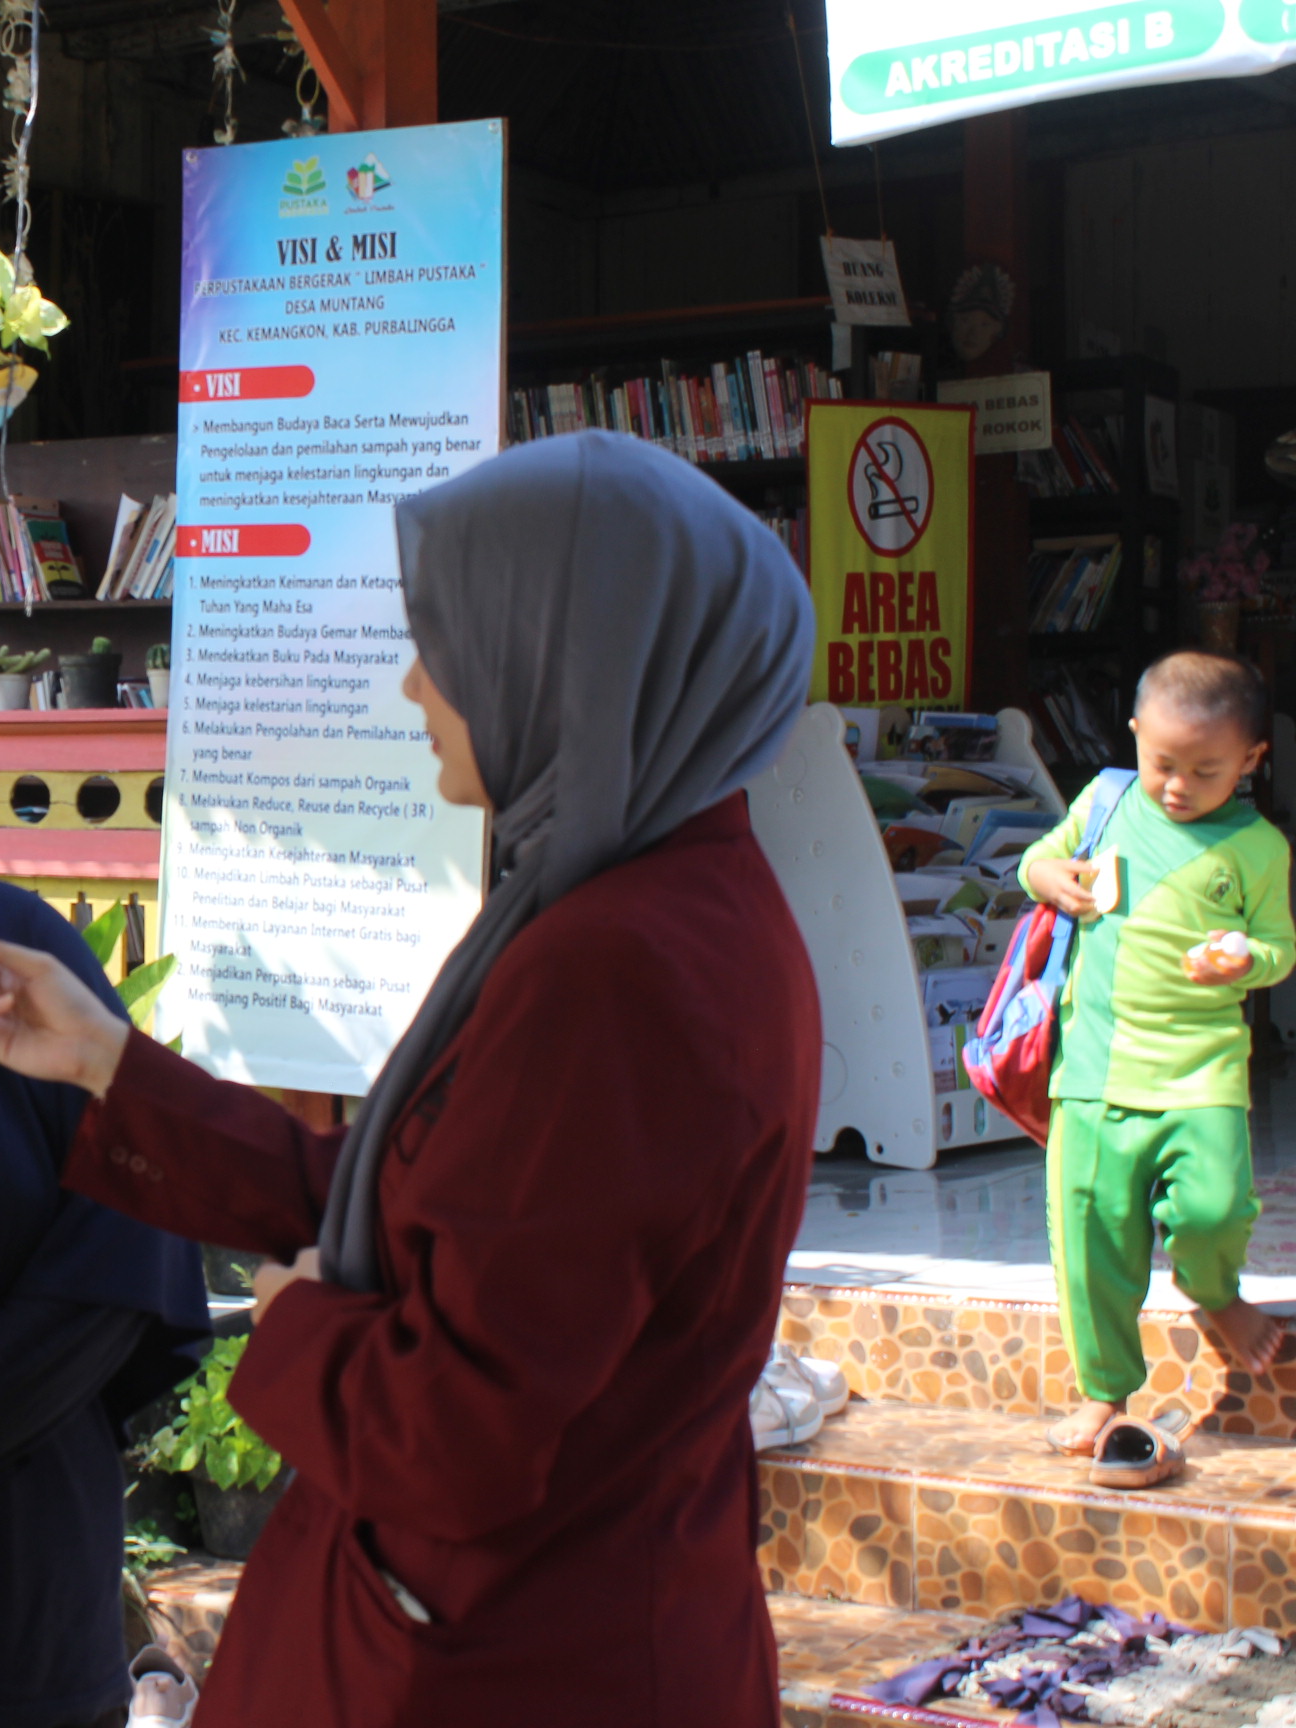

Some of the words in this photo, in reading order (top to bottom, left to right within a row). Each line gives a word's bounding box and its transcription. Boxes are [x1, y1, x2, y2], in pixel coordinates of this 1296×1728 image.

[884, 17, 1130, 98] AKREDITASI
[1145, 11, 1175, 49] B
[277, 238, 318, 266] VISI
[325, 235, 343, 263] &
[351, 232, 397, 260] MISI
[194, 276, 285, 296] PERPUSTAKAAN
[289, 273, 351, 290] BERGERAK
[365, 268, 414, 285] LIMBAH
[418, 265, 476, 282] PUSTAKA
[285, 300, 316, 315] DESA
[319, 296, 385, 313] MUNTANG
[219, 327, 243, 343] KEC.
[247, 323, 329, 342] KEMANGKON,
[333, 321, 361, 337] KAB.
[364, 318, 456, 336] PURBALINGGA
[206, 373, 241, 397] VISI
[985, 395, 1039, 410] BEBAS
[204, 419, 274, 436] Membangun
[278, 417, 319, 434] Budaya
[323, 416, 351, 429] Baca
[354, 415, 385, 428] Serta
[389, 412, 468, 430] Mewujudkan
[983, 420, 1042, 436] ROKOK
[201, 444, 268, 460] Pengelolaan
[272, 444, 293, 456] dan
[296, 441, 358, 459] pemilahan
[362, 440, 408, 457] sampah
[411, 441, 441, 455] yang
[446, 438, 481, 452] benar
[200, 468, 232, 483] untuk
[235, 469, 283, 485] menjaga
[288, 465, 350, 480] kelestarian
[354, 465, 422, 482] lingkungan
[426, 464, 449, 478] dan
[200, 493, 279, 509] meningkatkan
[283, 491, 363, 508] kesejahteraan
[202, 529, 239, 553] MISI
[200, 576, 275, 593] Meningkatkan
[279, 576, 333, 589] Keimanan
[336, 576, 357, 589] dan
[200, 601, 230, 614] Tuhan
[234, 601, 259, 618] Yang
[263, 602, 292, 614] Maha
[295, 602, 312, 614] Esa
[842, 571, 941, 635] AREA
[199, 625, 274, 641] Meningkatkan
[278, 625, 317, 642] Budaya
[321, 625, 357, 638] Gemar
[361, 626, 413, 639] Membac
[198, 649, 269, 663] Mendekatkan
[273, 650, 300, 663] Buku
[304, 651, 330, 664] Pada
[333, 651, 399, 668] Masyarakat
[828, 637, 952, 703] BEBAS
[196, 674, 242, 688] Menjaga
[245, 674, 303, 688] kebersihan
[306, 675, 369, 692] lingkungan
[195, 698, 241, 713] Menjaga
[243, 699, 303, 713] kelestarian
[306, 700, 368, 717] lingkungan
[194, 722, 252, 736] Melakukan
[256, 724, 319, 741] Pengolahan
[322, 725, 343, 738] dan
[347, 727, 406, 741] Pemilahan
[409, 730, 435, 741] sam
[192, 748, 218, 763] yang
[222, 747, 252, 760] benar
[192, 771, 243, 785] Membuat
[247, 772, 290, 789] Kompos
[294, 774, 315, 787] dari
[318, 775, 361, 792] sampah
[365, 776, 410, 792] Organik
[191, 795, 249, 810] Melakukan
[253, 798, 295, 813] Reduce,
[298, 800, 330, 813] Reuse
[333, 800, 355, 814] dan
[358, 802, 400, 819] Recycle
[234, 821, 256, 835] Non
[259, 821, 303, 837] Organik
[269, 847, 346, 866] Kesejahteraan
[349, 851, 415, 869] Masyarakat
[194, 867, 255, 884] Menjadikan
[260, 871, 300, 884] Limbah
[304, 875, 346, 888] Pustaka
[350, 876, 393, 894] sebagai
[397, 879, 428, 893] Pusat
[193, 891, 244, 907] Penelitian
[248, 896, 268, 909] dan
[272, 897, 309, 913] Belajar
[313, 899, 336, 915] bagi
[340, 900, 405, 917] Masyarakat
[192, 916, 259, 932] Memberikan
[263, 921, 307, 936] Layanan
[311, 924, 355, 938] Internet
[359, 927, 392, 941] Gratis
[396, 930, 421, 946] bagi
[190, 940, 251, 957] Masyarakat
[190, 964, 252, 981] Menjadikan
[256, 970, 330, 988] Perpustakaan
[333, 973, 375, 991] sebagai
[379, 978, 410, 992] Pusat
[252, 993, 287, 1007] Positif
[318, 1000, 382, 1017] Masyarakat
